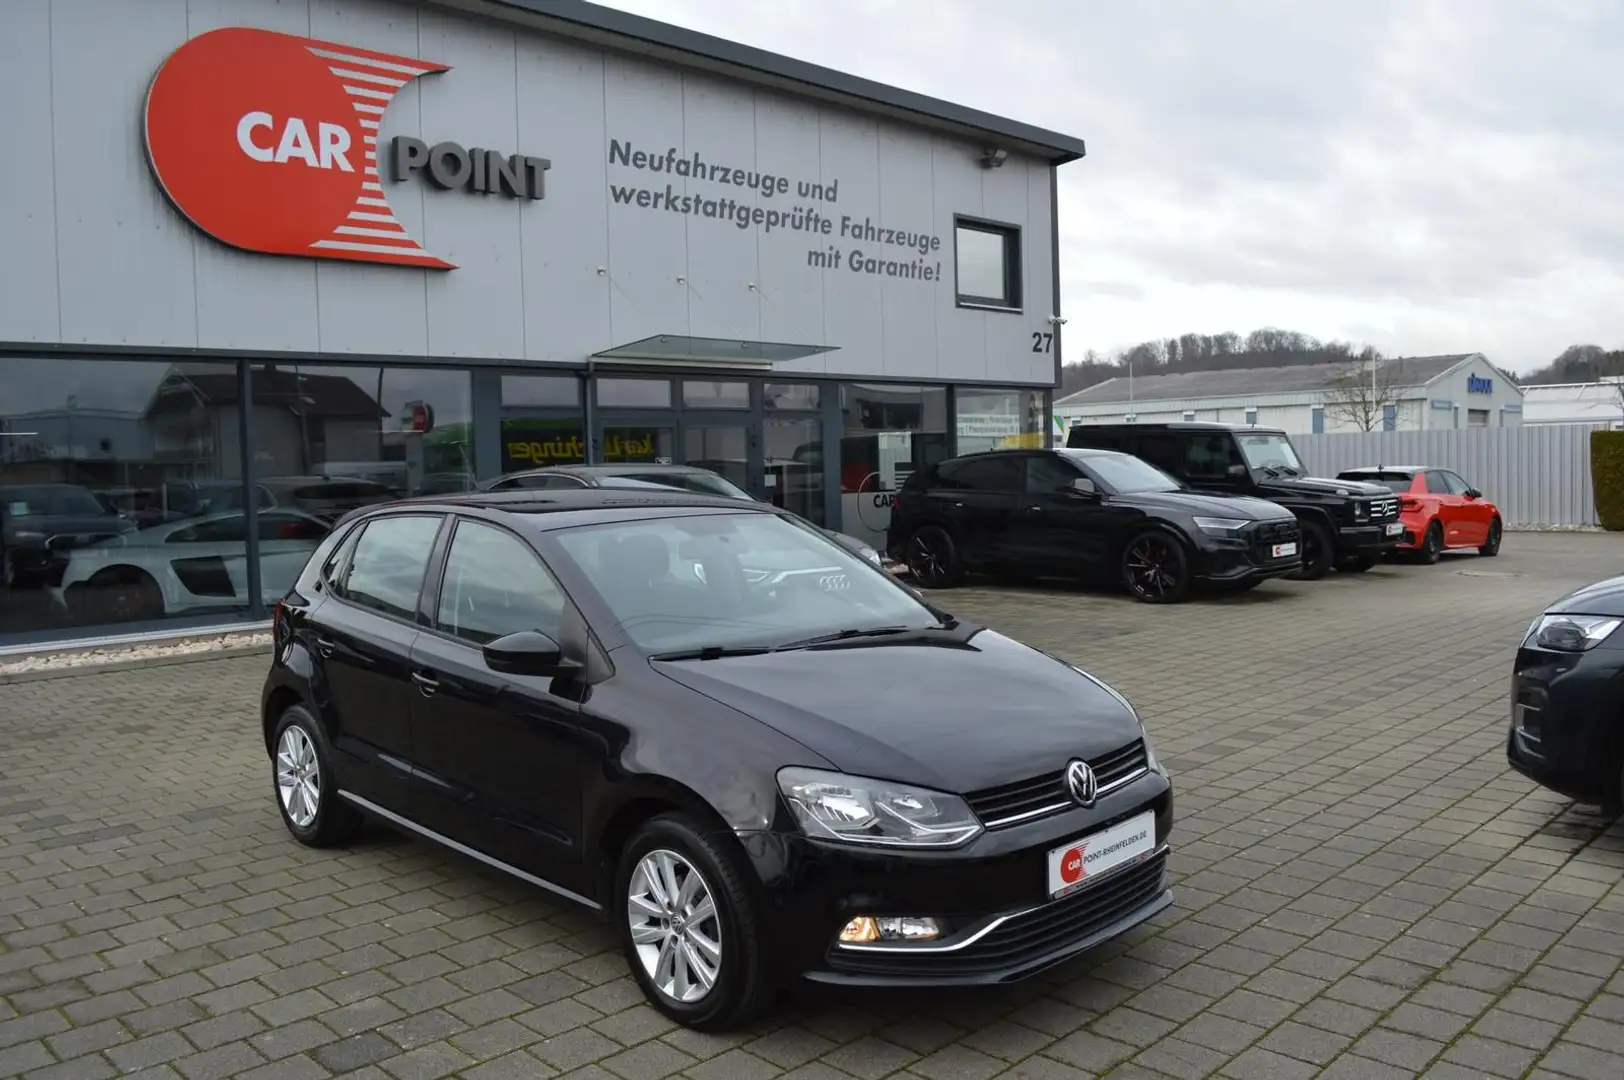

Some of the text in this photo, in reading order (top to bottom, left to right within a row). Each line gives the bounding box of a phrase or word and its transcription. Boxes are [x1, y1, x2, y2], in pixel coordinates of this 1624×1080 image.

[236, 111, 551, 200] CAR POINT
[608, 138, 839, 202] Neufahrzeuge und
[610, 184, 941, 254] werkstattgeprüfte Fahrzeuge
[807, 245, 941, 282] mit Garantie!
[1031, 331, 1054, 353] 27
[1067, 830, 1148, 871] CAR POINT-RHEINFELDEN.DE
